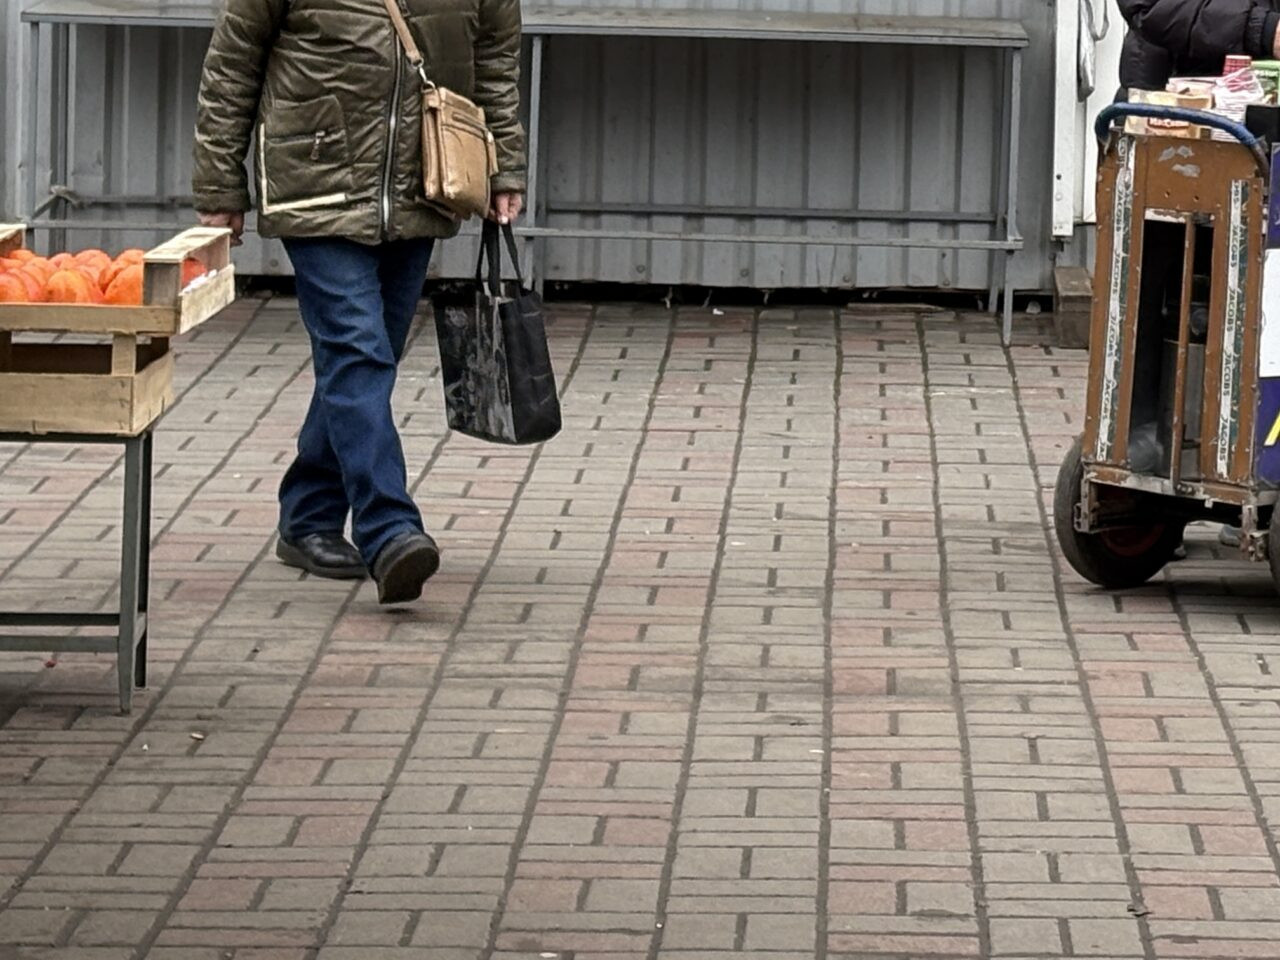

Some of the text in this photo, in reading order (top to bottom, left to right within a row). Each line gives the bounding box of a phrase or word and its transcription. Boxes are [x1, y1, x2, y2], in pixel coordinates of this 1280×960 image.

[1226, 287, 1237, 332] JACOBS
[1222, 351, 1233, 397] JACOBS
[1218, 413, 1229, 461] JACOBS
